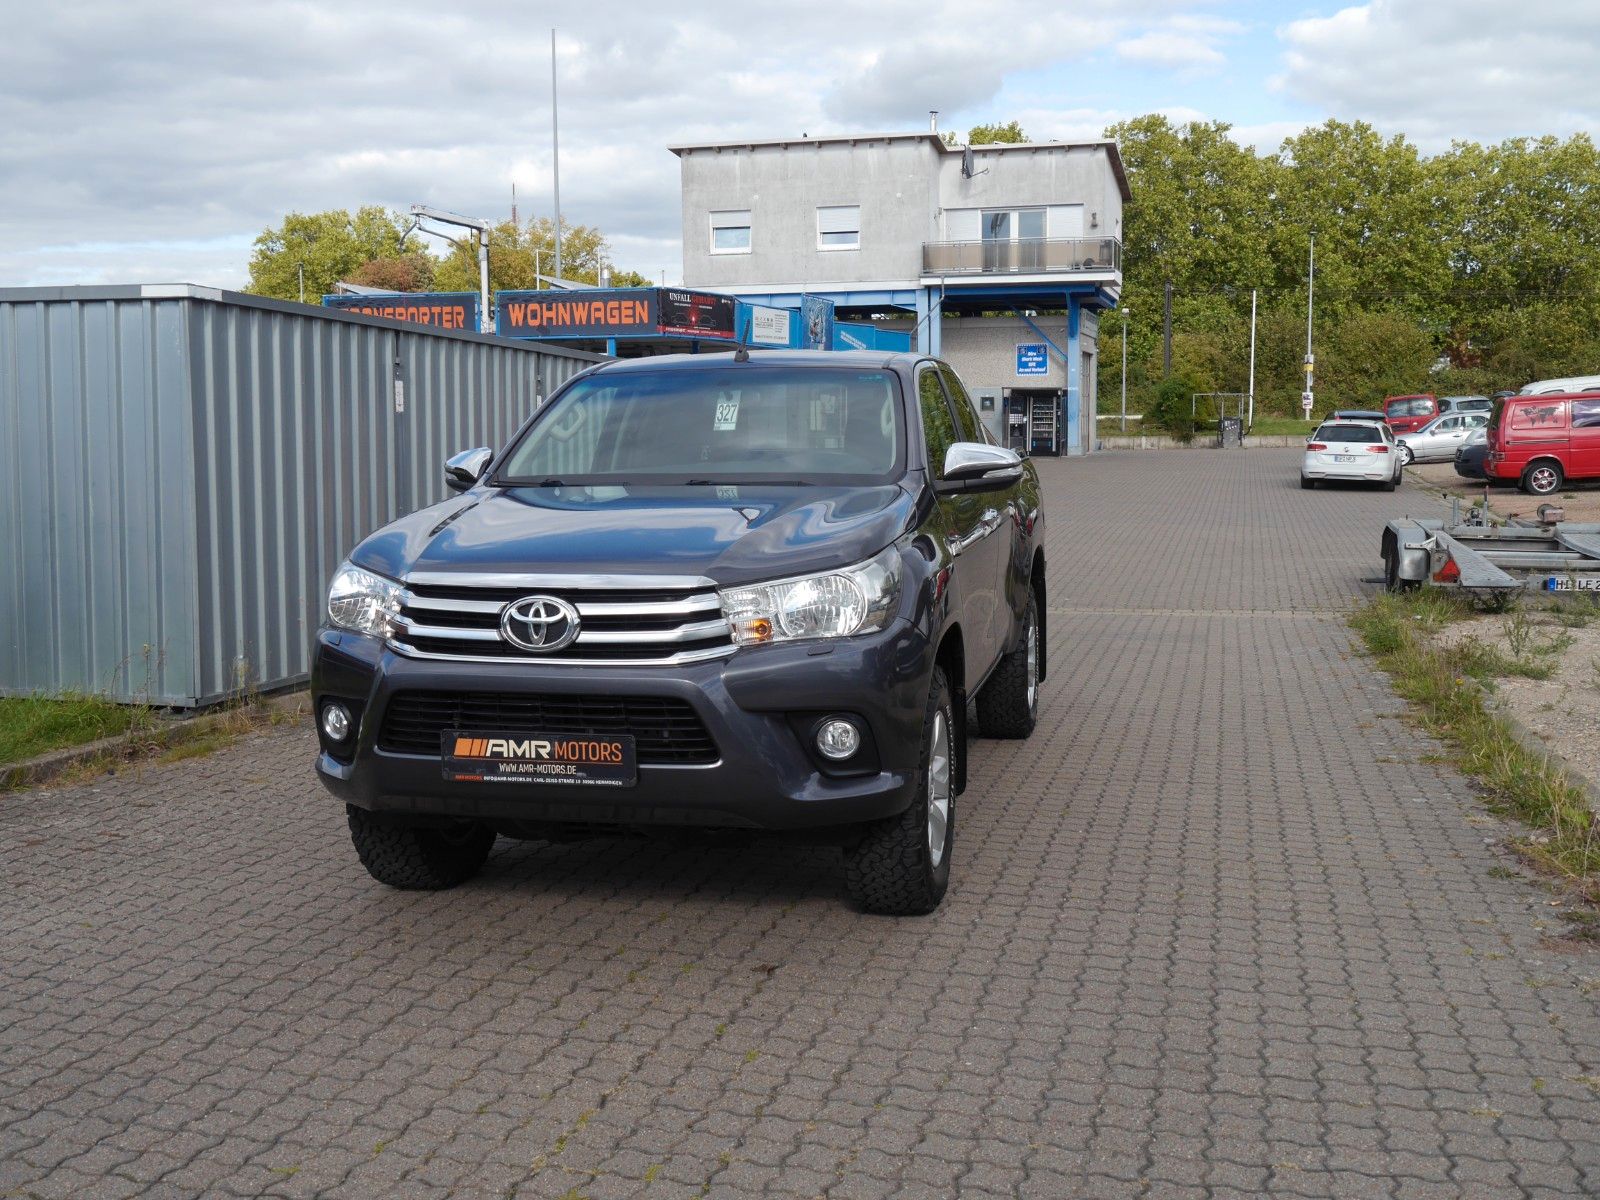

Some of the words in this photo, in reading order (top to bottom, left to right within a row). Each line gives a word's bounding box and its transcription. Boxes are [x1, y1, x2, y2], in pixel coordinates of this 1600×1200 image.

[669, 292, 691, 302] UNFALL
[339, 306, 465, 329] SPORTER
[508, 300, 649, 327] WOHNWAGEN
[716, 405, 737, 422] 327
[1556, 580, 1570, 590] HI
[485, 738, 551, 759] AMR
[554, 741, 623, 762] MOTORS
[498, 762, 577, 775] WWW.AMR-MOTORS.DE
